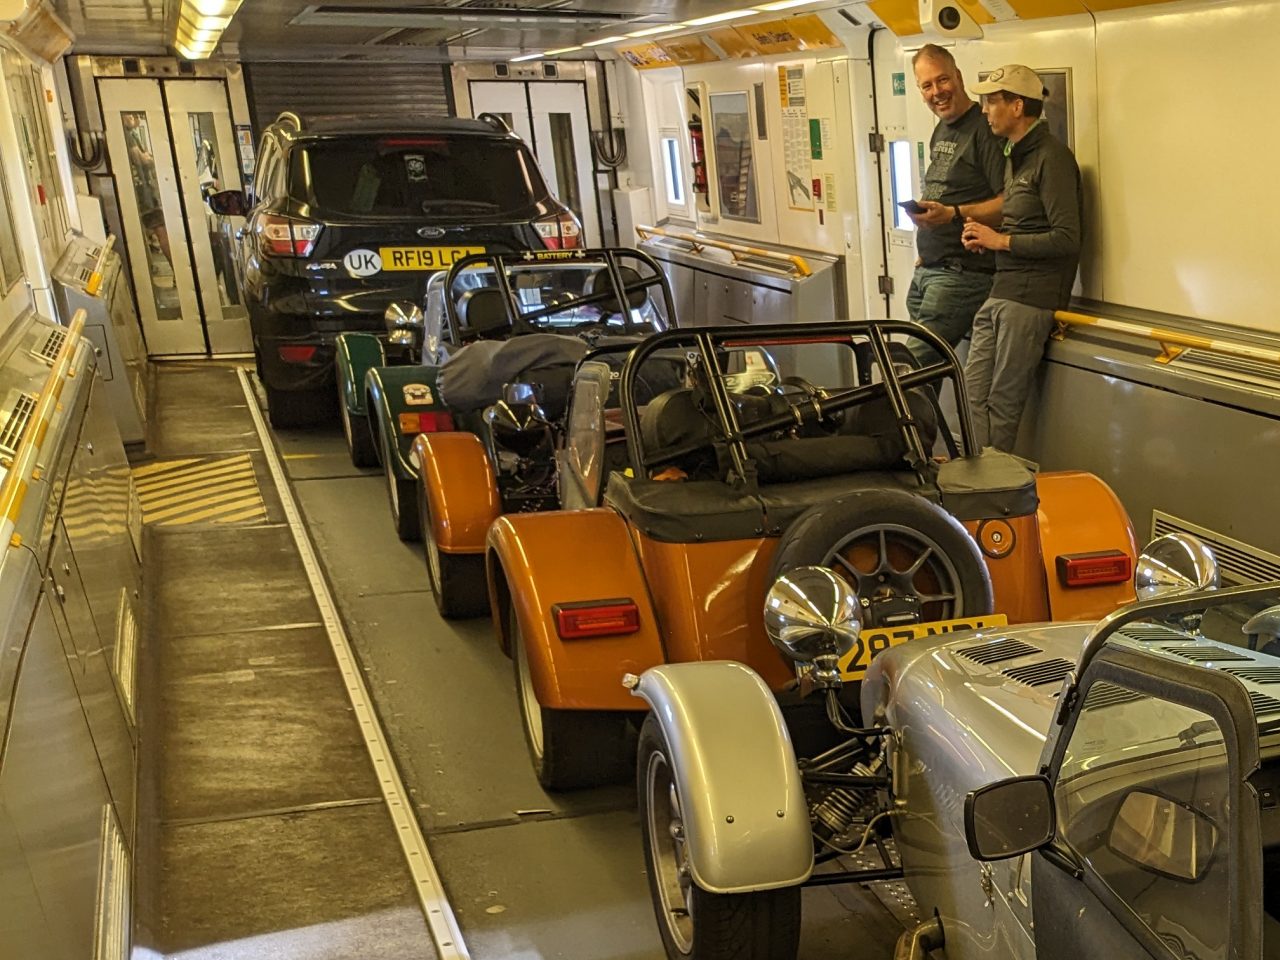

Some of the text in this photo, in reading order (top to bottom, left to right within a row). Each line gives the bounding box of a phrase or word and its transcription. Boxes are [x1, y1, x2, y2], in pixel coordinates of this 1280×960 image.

[350, 254, 378, 270] UK
[393, 250, 433, 267] RF19
[537, 252, 573, 260] BATTERY
